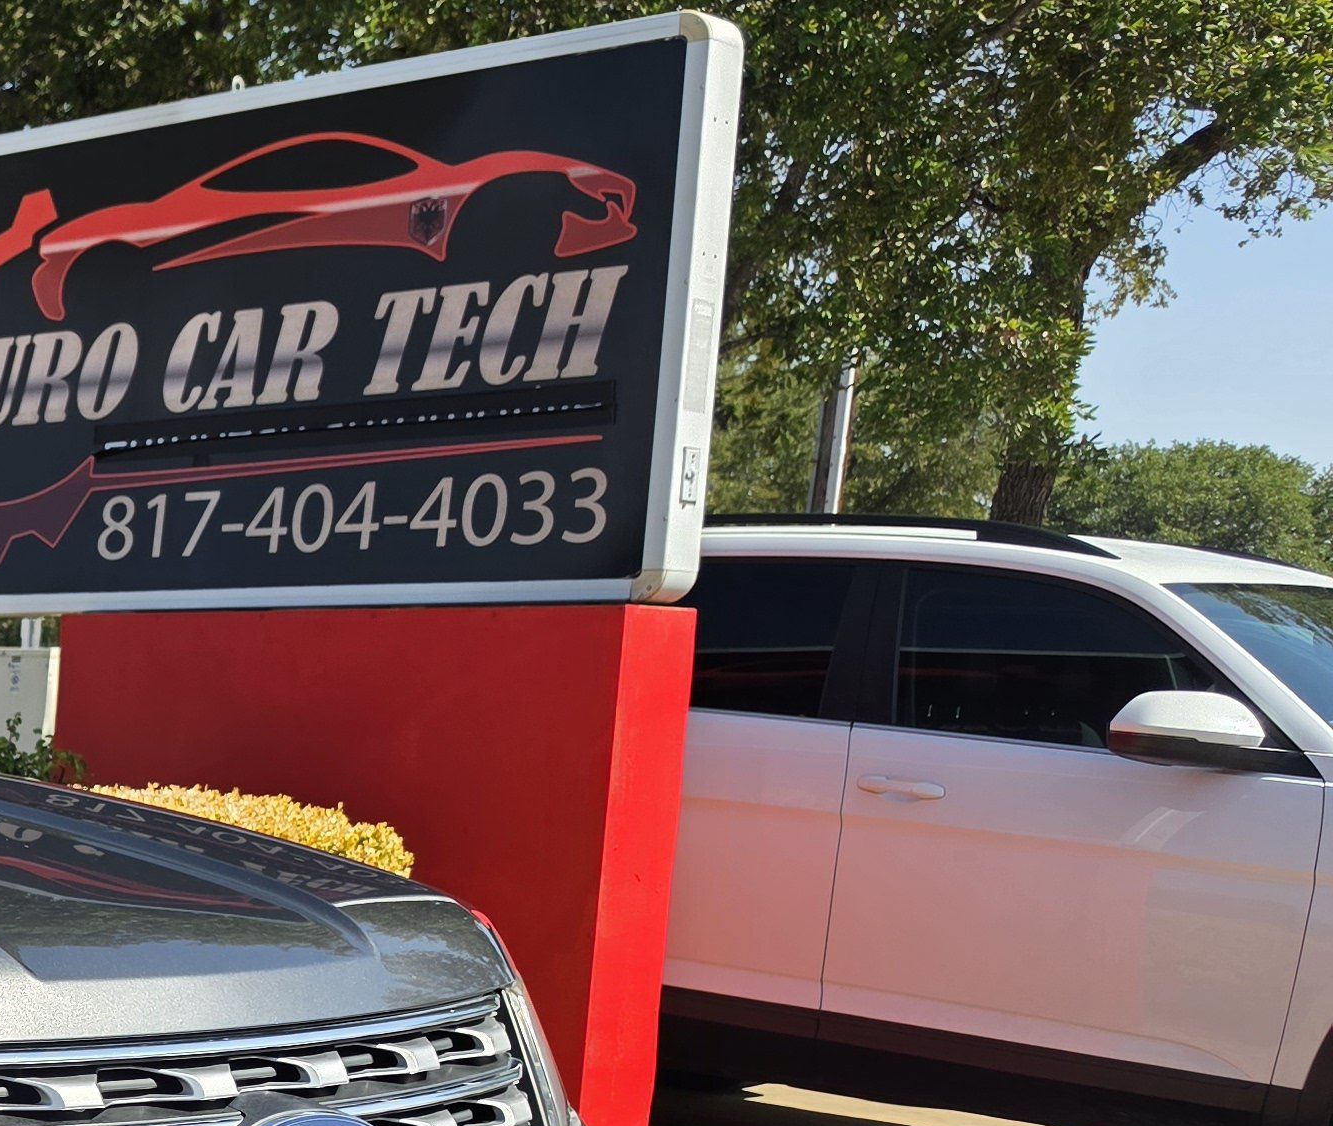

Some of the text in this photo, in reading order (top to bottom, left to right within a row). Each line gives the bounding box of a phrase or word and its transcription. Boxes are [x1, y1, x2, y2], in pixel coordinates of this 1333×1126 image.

[163, 300, 339, 414] CAR
[363, 265, 629, 397] TECH
[97, 467, 608, 561] 817-404-4033
